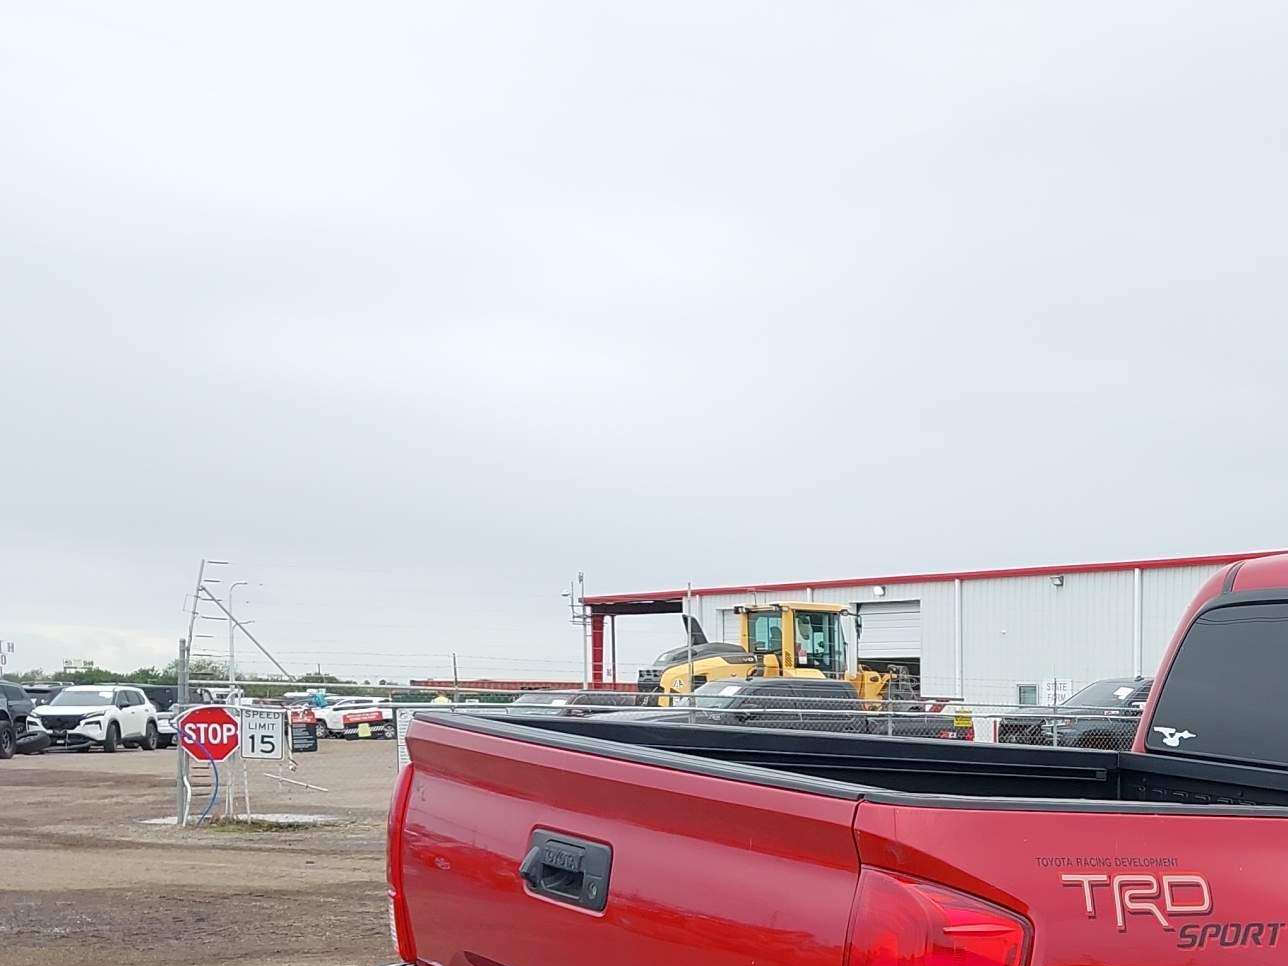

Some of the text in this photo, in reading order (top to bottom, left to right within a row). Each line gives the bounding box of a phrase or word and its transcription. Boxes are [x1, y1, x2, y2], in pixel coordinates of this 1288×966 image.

[244, 710, 280, 720] SPEED
[184, 722, 236, 745] STOP
[248, 722, 277, 731] LIMIT
[248, 734, 276, 754] 15
[1036, 857, 1179, 868] TOYOTA RACING DEVELOPMENT
[1061, 873, 1214, 933] TRD
[1176, 922, 1286, 949] SPORT
